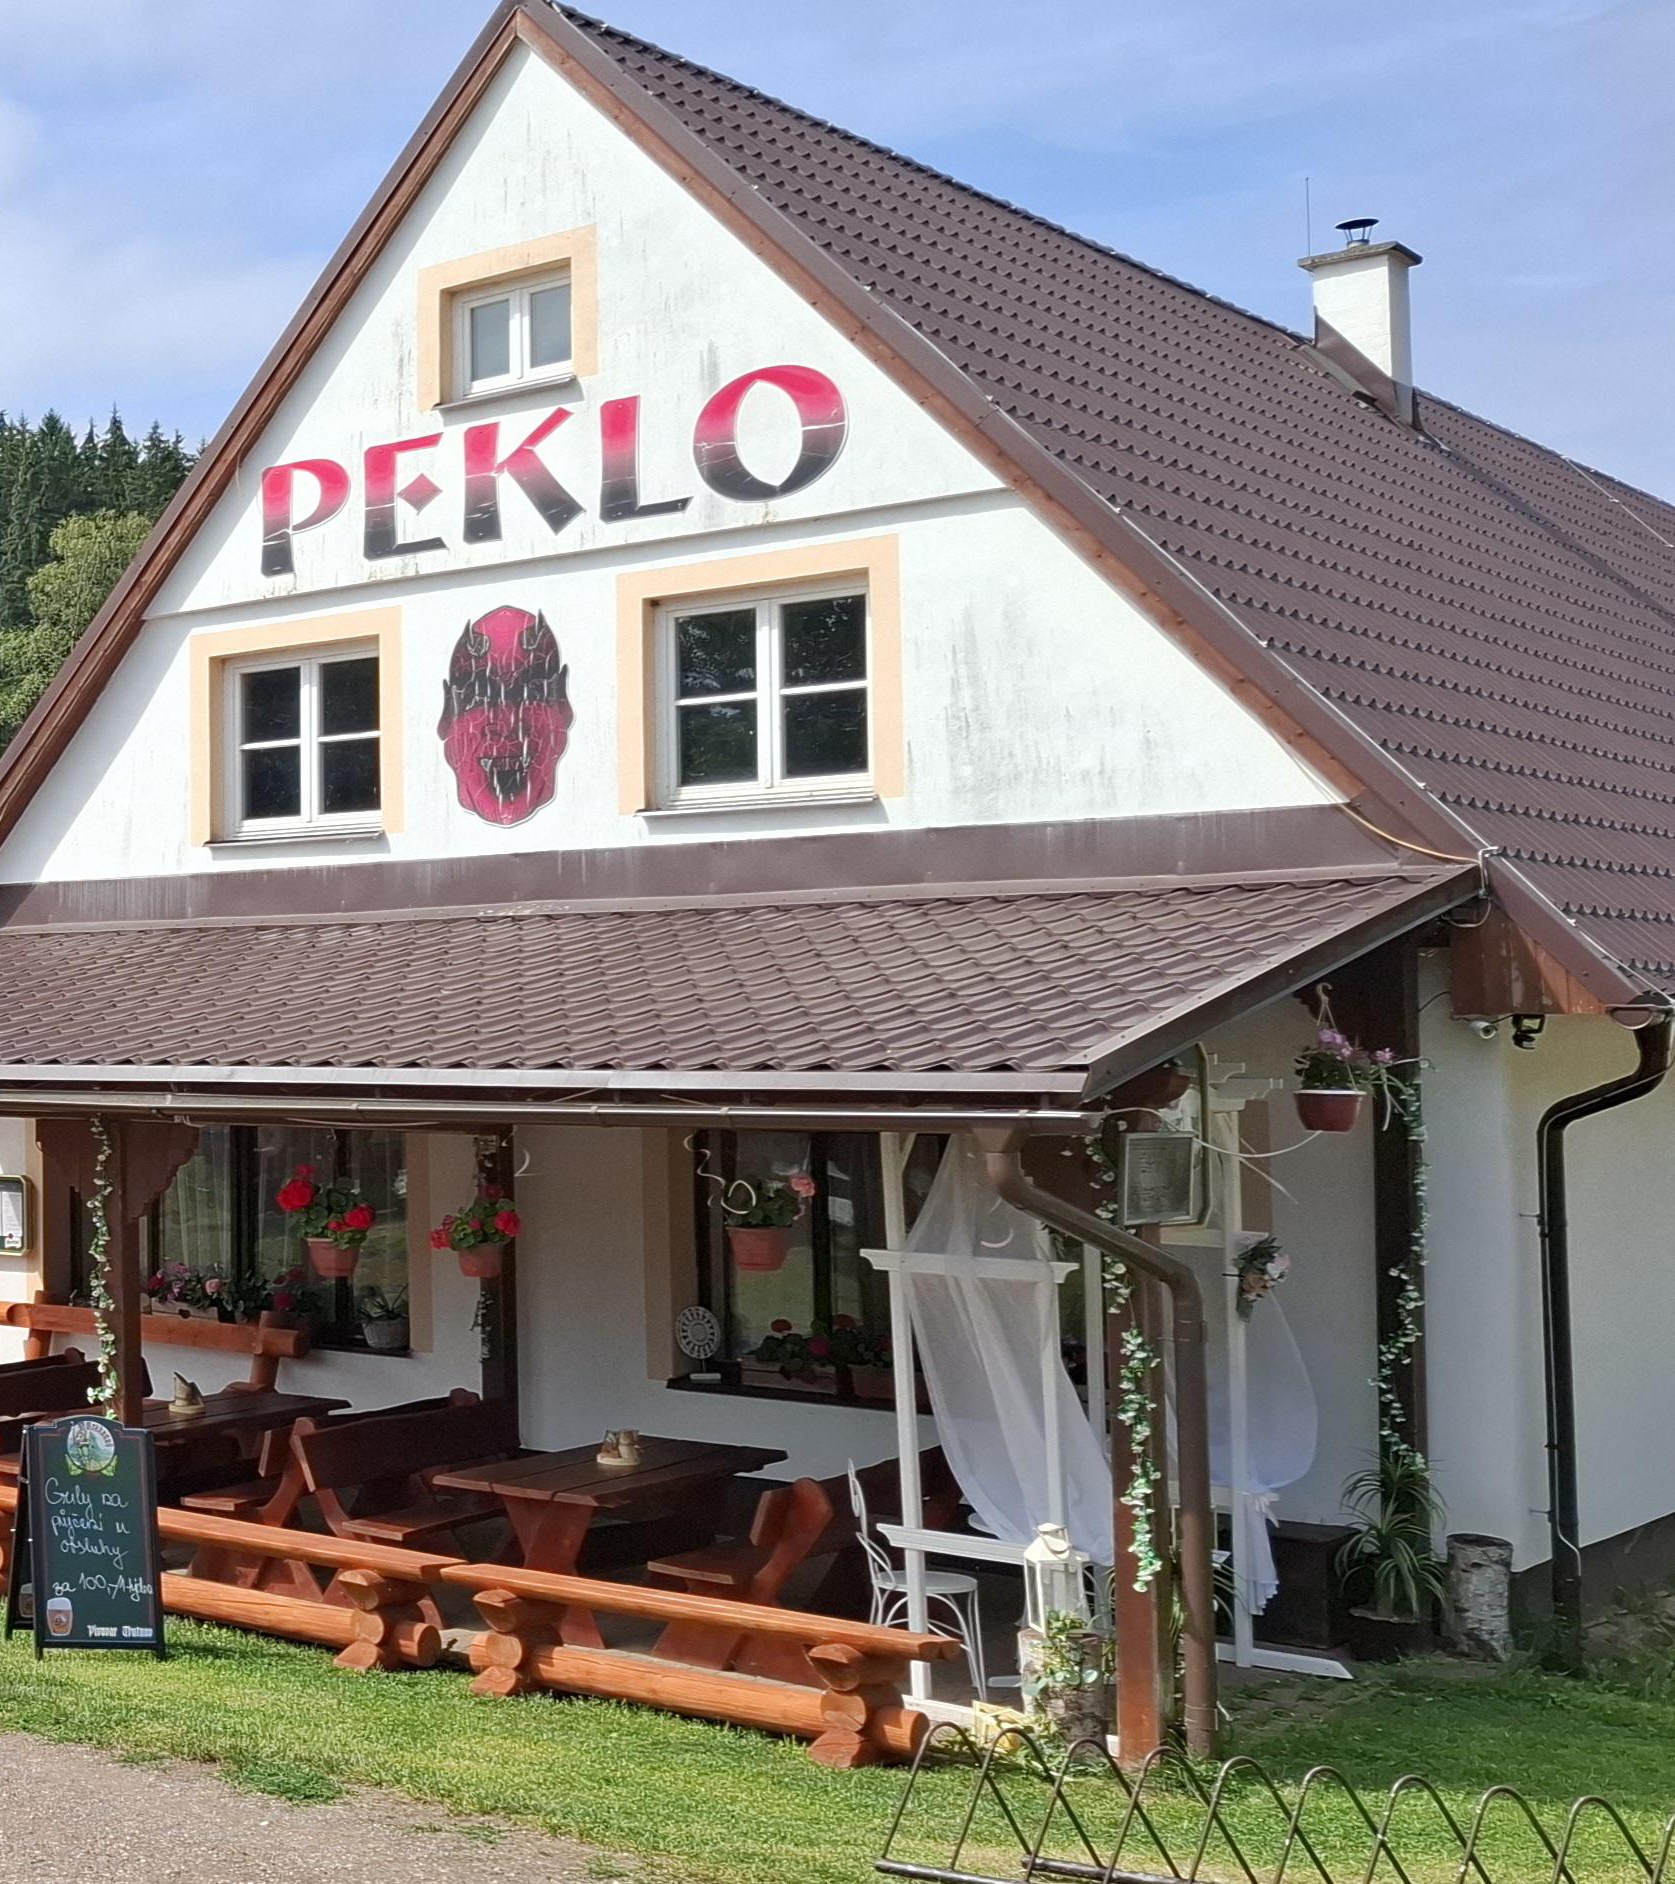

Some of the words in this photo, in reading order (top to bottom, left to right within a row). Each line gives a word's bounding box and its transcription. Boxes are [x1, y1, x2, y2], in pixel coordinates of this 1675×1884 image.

[260, 364, 849, 578] PEKLO
[45, 1477, 94, 1520] Grily
[116, 1521, 131, 1534] u
[60, 1537, 130, 1571] obsluhy
[52, 1582, 77, 1597] za
